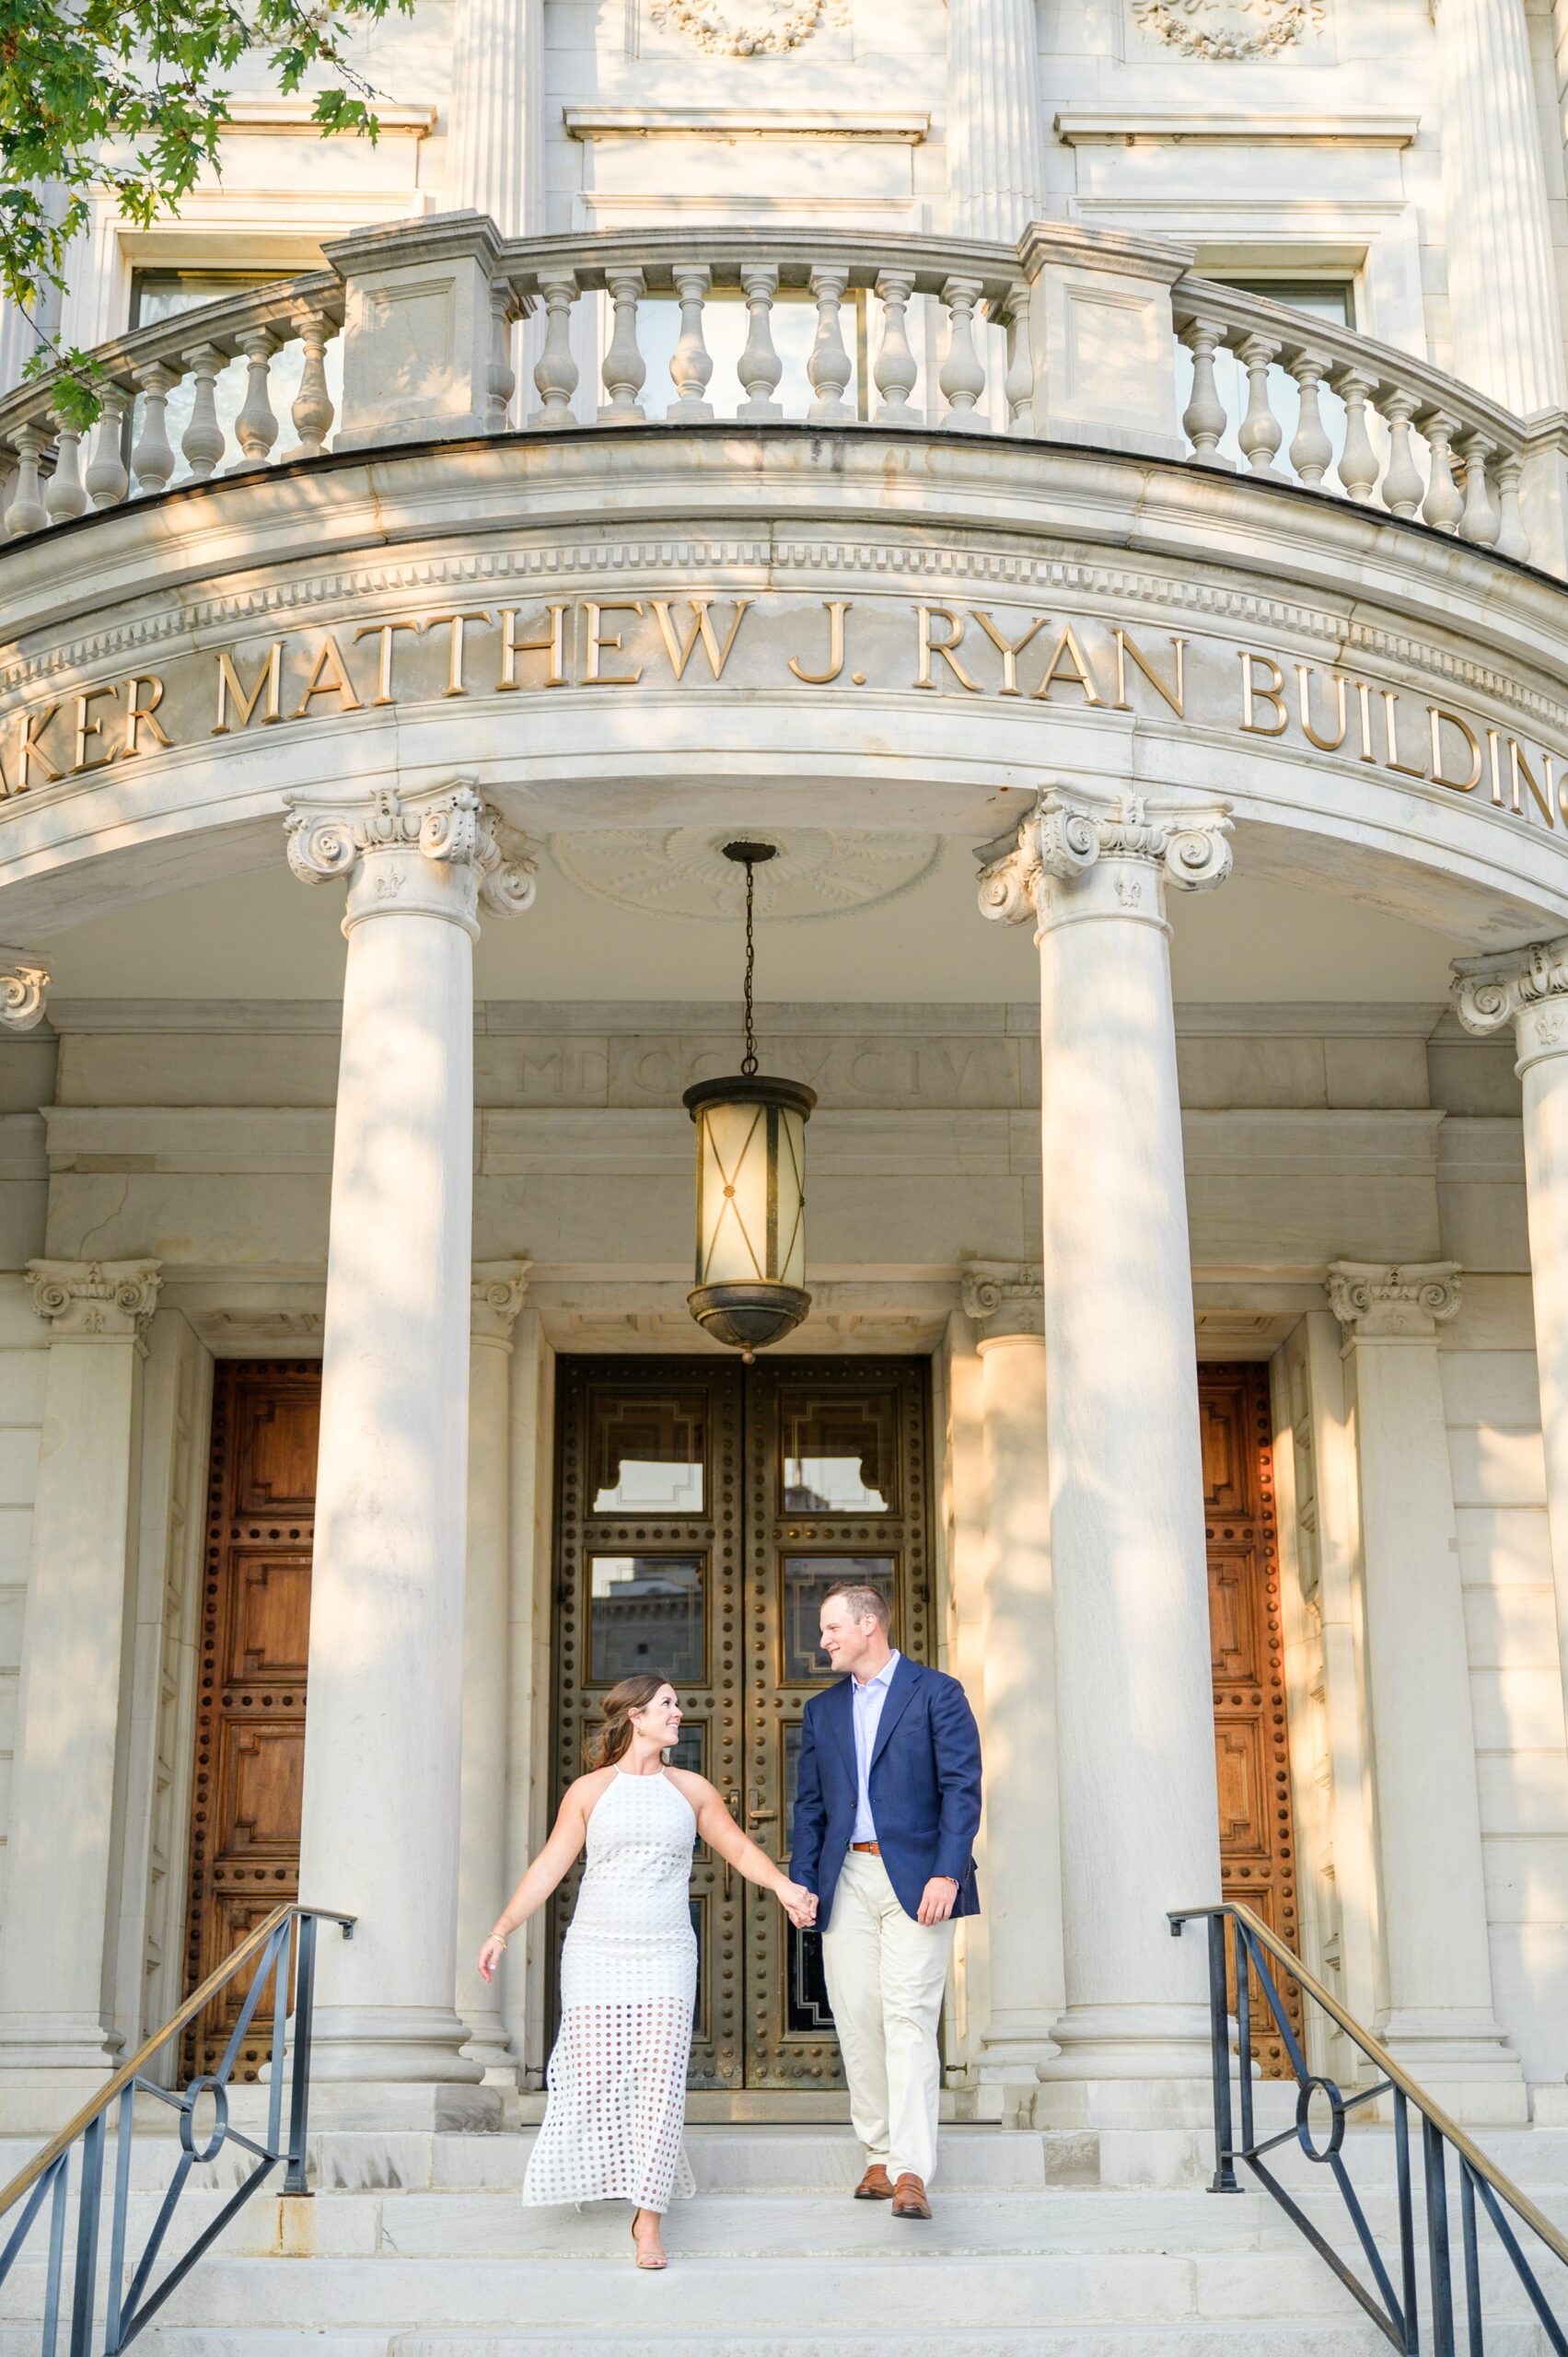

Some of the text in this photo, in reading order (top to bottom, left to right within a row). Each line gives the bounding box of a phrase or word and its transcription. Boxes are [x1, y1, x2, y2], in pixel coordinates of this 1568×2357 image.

[0, 599, 1568, 830] KER MATTHEW J. RYAN BUILDIN
